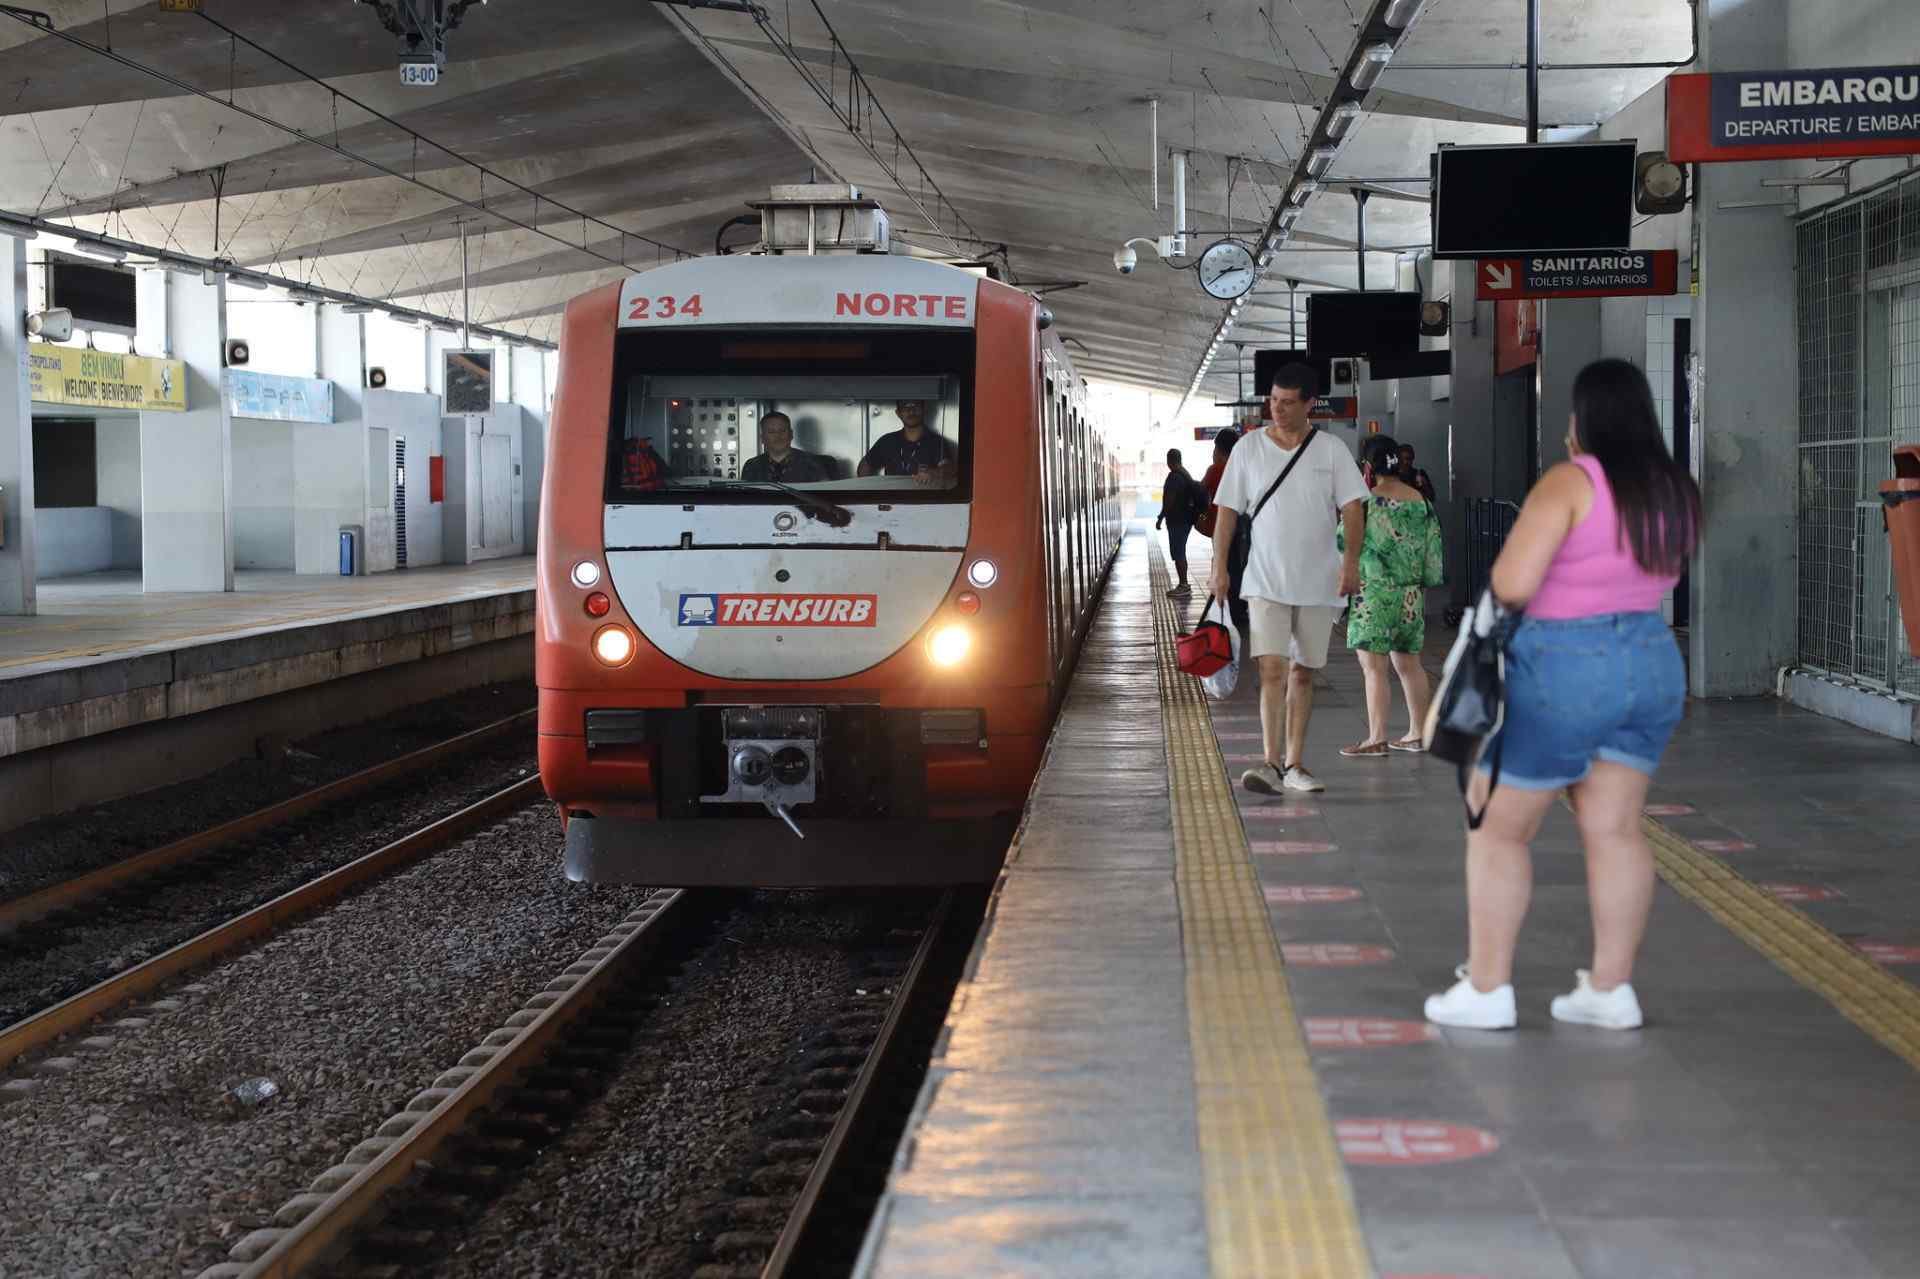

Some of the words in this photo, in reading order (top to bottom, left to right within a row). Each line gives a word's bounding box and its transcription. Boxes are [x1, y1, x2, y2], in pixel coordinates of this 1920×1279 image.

[401, 67, 436, 82] 13-00
[1725, 117, 1841, 137] DEPARTURE
[1529, 276, 1573, 287] TOILETS
[1582, 274, 1648, 286] SANITARIOS
[628, 295, 703, 319] 234
[836, 293, 966, 318] NORTE
[64, 378, 97, 400] WELCOME
[101, 381, 143, 402] BIENVENIDOS
[722, 599, 872, 622] TRENSURB
